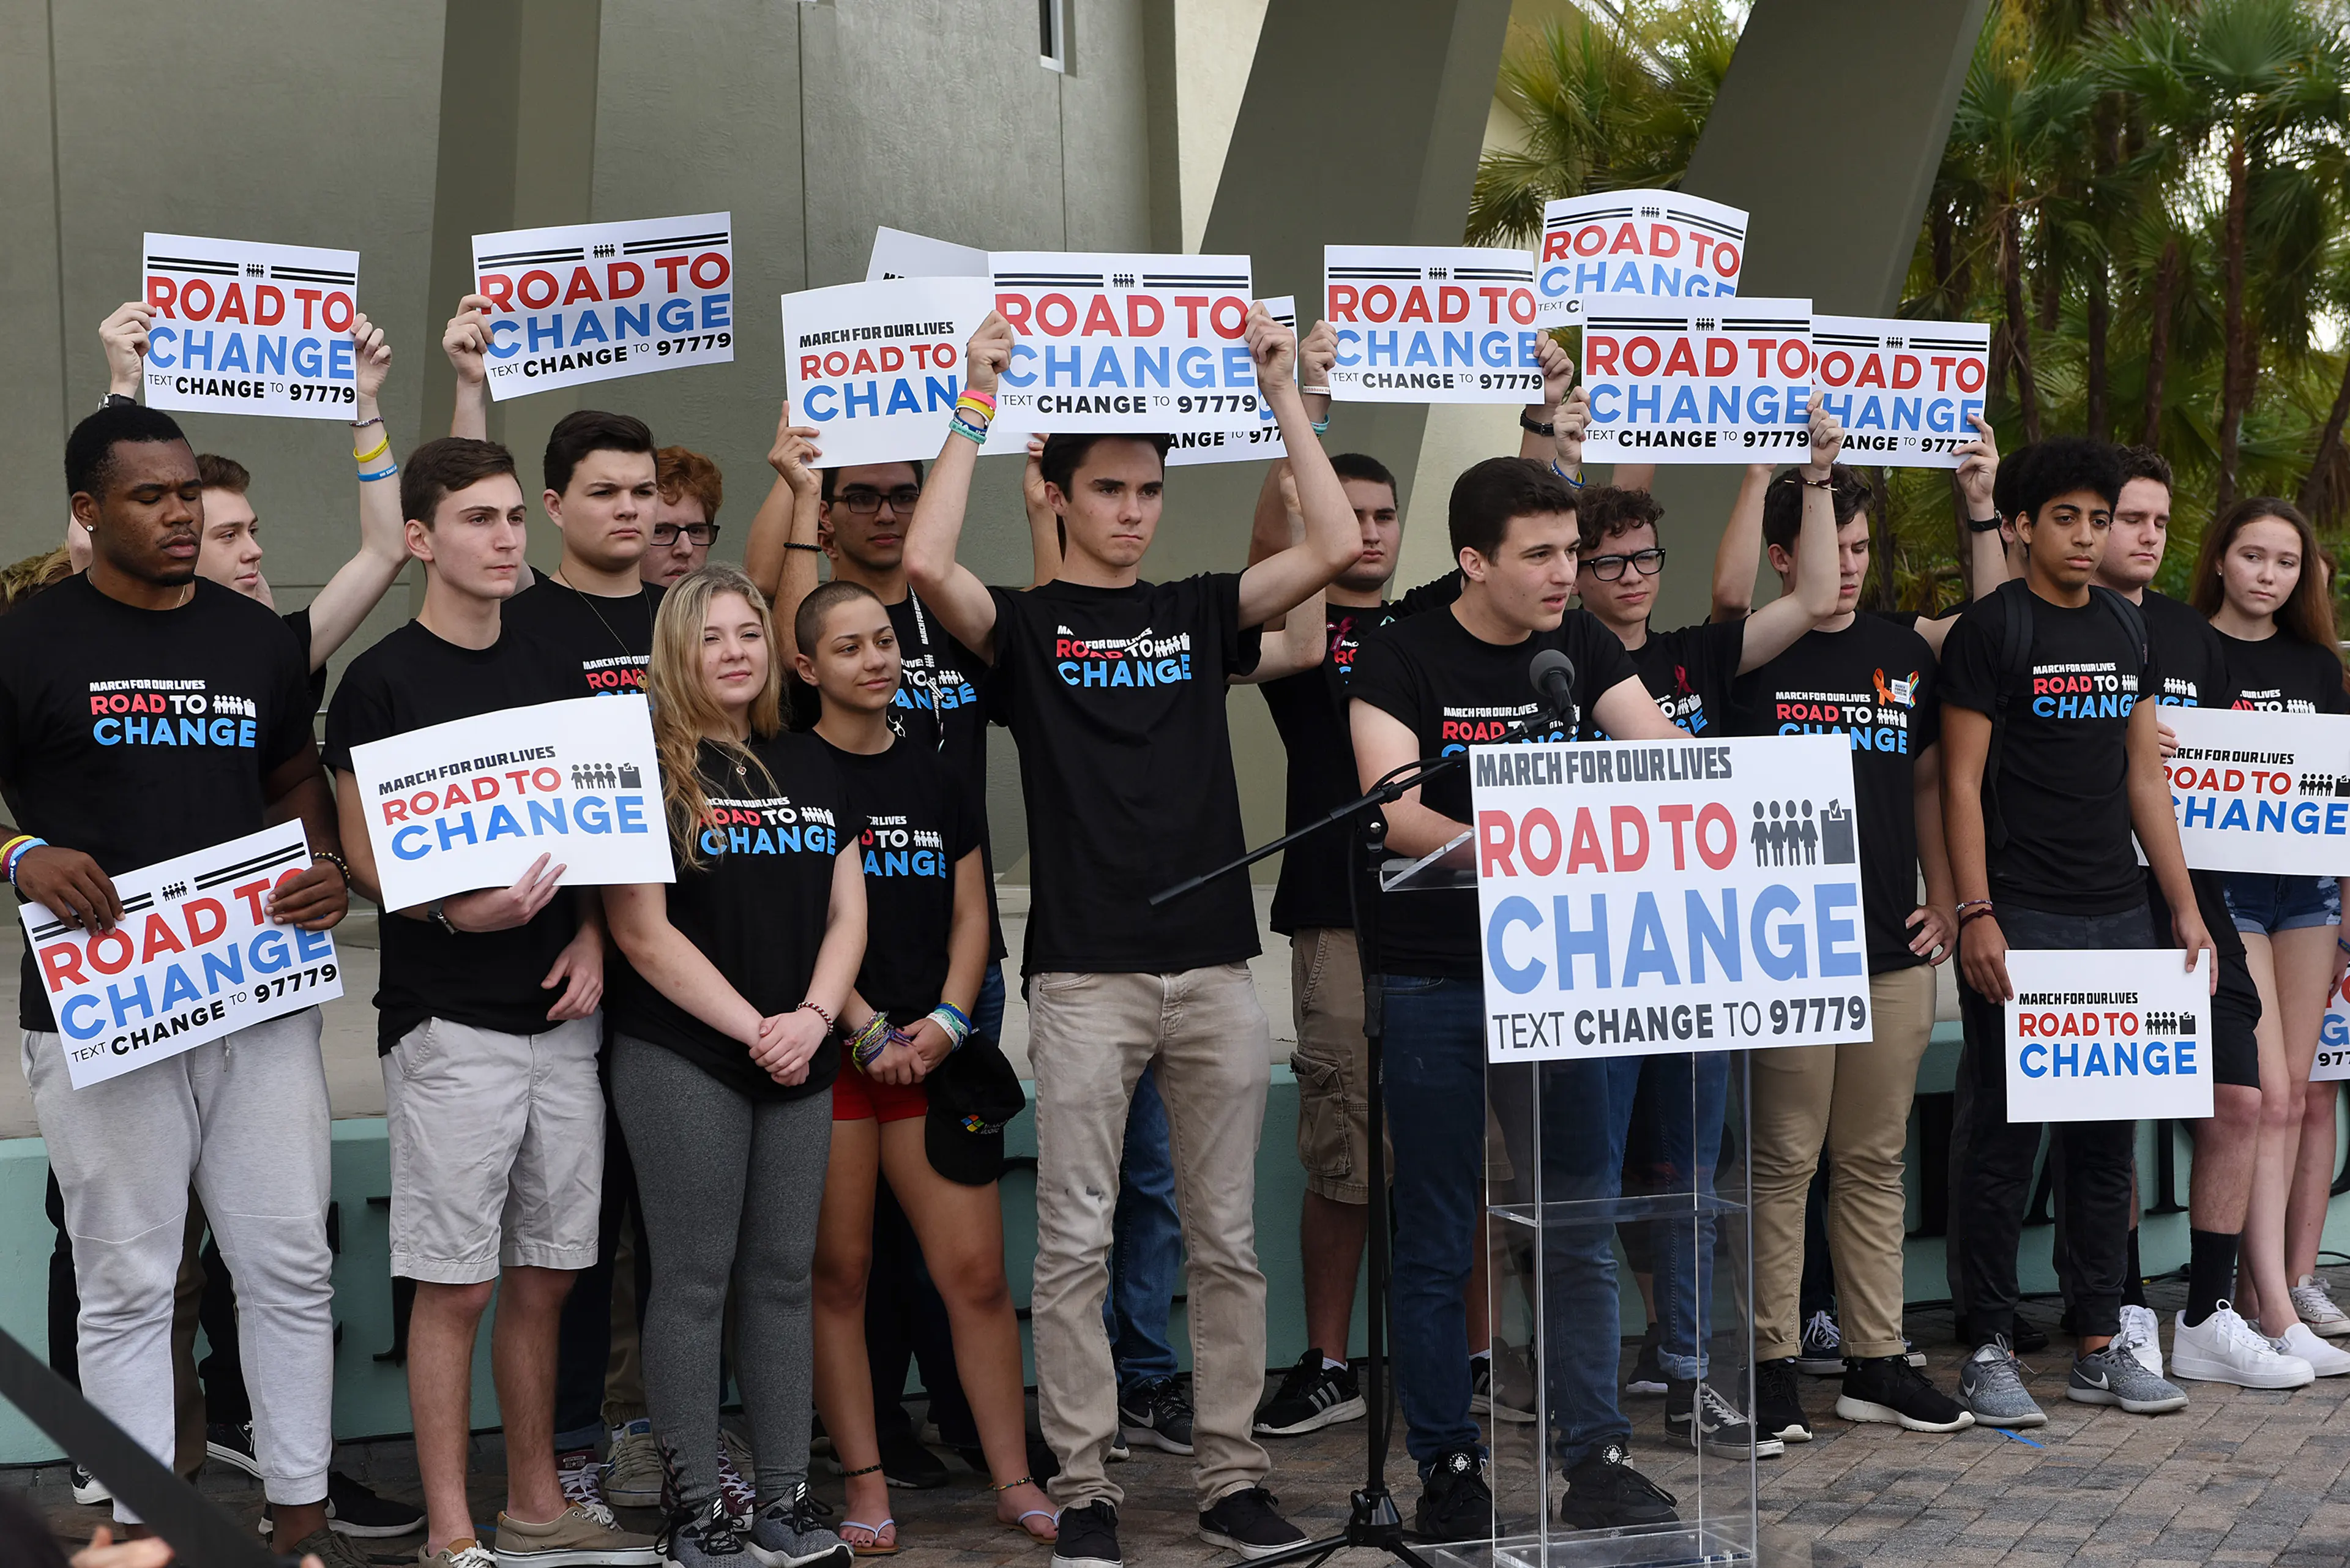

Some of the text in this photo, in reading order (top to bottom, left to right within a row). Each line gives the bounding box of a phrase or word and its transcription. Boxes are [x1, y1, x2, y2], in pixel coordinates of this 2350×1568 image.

[1543, 223, 1739, 277] ROAD TO
[480, 253, 729, 315] ROAD TO
[148, 277, 354, 332] ROAD TO
[996, 294, 1248, 339] ROAD TO
[1329, 285, 1536, 324] ROAD TO
[1540, 302, 1561, 311] TEXT
[488, 293, 730, 359] CHANGE
[800, 322, 953, 348] MARCH FOR OUR LIVES
[147, 327, 354, 379] CHANGE
[491, 333, 731, 377] TEXT CHANGE TO 97779
[802, 344, 957, 380] ROAD TO
[1335, 329, 1539, 367] CHANGE
[1587, 337, 1810, 378] ROAD TO
[1002, 345, 1255, 388] CHANGE
[1931, 357, 1985, 393] TO
[149, 375, 355, 403] TEXT CHANGE TO 97779
[1363, 373, 1453, 389] CHANGE
[1480, 375, 1542, 389] 97779
[804, 375, 958, 421] CHAN
[1002, 395, 1032, 405] TEXT
[1037, 395, 1146, 413] CHANGE
[1153, 397, 1169, 406] TO
[1178, 395, 1256, 413] 97779
[1589, 384, 1810, 424] CHANGE
[1822, 393, 1983, 433] HANGE
[1169, 432, 1224, 449] ANGE
[1249, 426, 1281, 444] 977
[1586, 430, 1809, 447] TEXT CHANGE TO 97779
[1841, 435, 1898, 450] ANGE
[1922, 438, 1977, 452] 977
[1057, 639, 1153, 659] ROAD TO
[1086, 640, 1106, 649] FOR
[1106, 640, 1127, 648] OUR
[583, 658, 615, 670] MARCH
[902, 669, 927, 686] TO
[1059, 654, 1192, 687] CHANGE
[2034, 665, 2065, 674] MARCH
[2096, 663, 2116, 671] LIVES
[90, 680, 205, 692] MARCH FOR OUR LIVES
[895, 682, 977, 710] ANGE
[1809, 692, 1826, 701] FOR
[2034, 675, 2118, 695] ROAD TO
[2257, 689, 2280, 698] LIVES
[91, 693, 206, 715] ROAD TO
[1444, 707, 1474, 717] MARCH
[1476, 707, 1491, 717] FOR
[1493, 707, 1512, 717] OUR
[1777, 704, 1871, 723] ROAD TO
[2033, 695, 2139, 719] CHANG
[2232, 700, 2283, 713] AD TO
[94, 717, 257, 747] CHANGE
[1443, 721, 1505, 740] ROAD
[1477, 752, 1562, 786] MARCH
[1566, 751, 1613, 783] FOR
[1616, 749, 1665, 782] OUR
[1668, 747, 1731, 780] LIVES
[2168, 748, 2294, 764] RCH FOR OUR LIVES
[379, 746, 555, 795] MARCH FOR OUR LIVES
[2252, 772, 2291, 794] TO
[383, 767, 561, 825] ROAD TO
[392, 796, 647, 861] CHANGE
[761, 808, 797, 825] TO
[879, 816, 906, 825] LIVES
[701, 825, 836, 855] CHANGE
[876, 830, 908, 848] TO
[1480, 803, 1736, 876] ROAD TO
[864, 850, 946, 878] ANGE
[40, 898, 226, 992] ROAD
[1488, 883, 1862, 994] CHANGE
[61, 912, 333, 1040] CHANGE
[72, 964, 337, 1062] TEXT CHANGE TO 97779
[2019, 993, 2138, 1005] MARCH FOR OUR LIVES
[1493, 996, 1865, 1049] TEXT CHANGE TO 97779
[2020, 1012, 2138, 1037] ROAD TO
[2020, 1042, 2197, 1078] CHANGE
